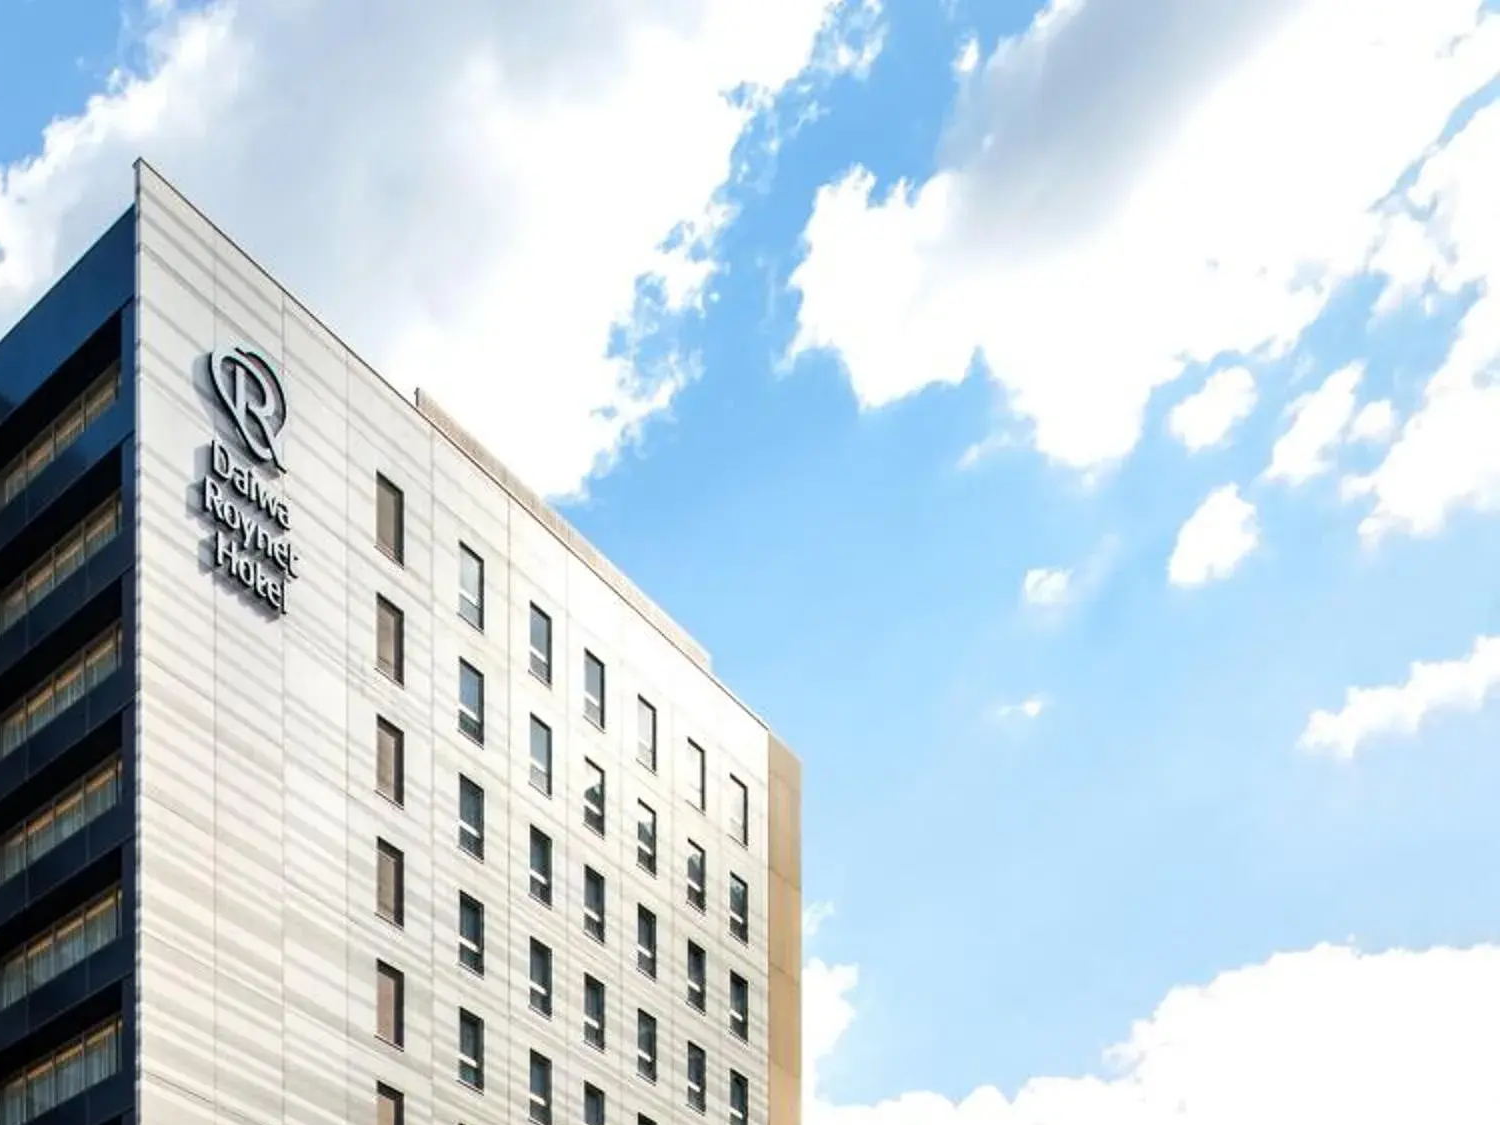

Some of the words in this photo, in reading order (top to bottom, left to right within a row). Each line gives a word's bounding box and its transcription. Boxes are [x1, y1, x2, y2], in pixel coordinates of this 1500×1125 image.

[203, 476, 299, 578] Roynet
[211, 438, 291, 530] Daiwa
[215, 531, 289, 615] Hotel
